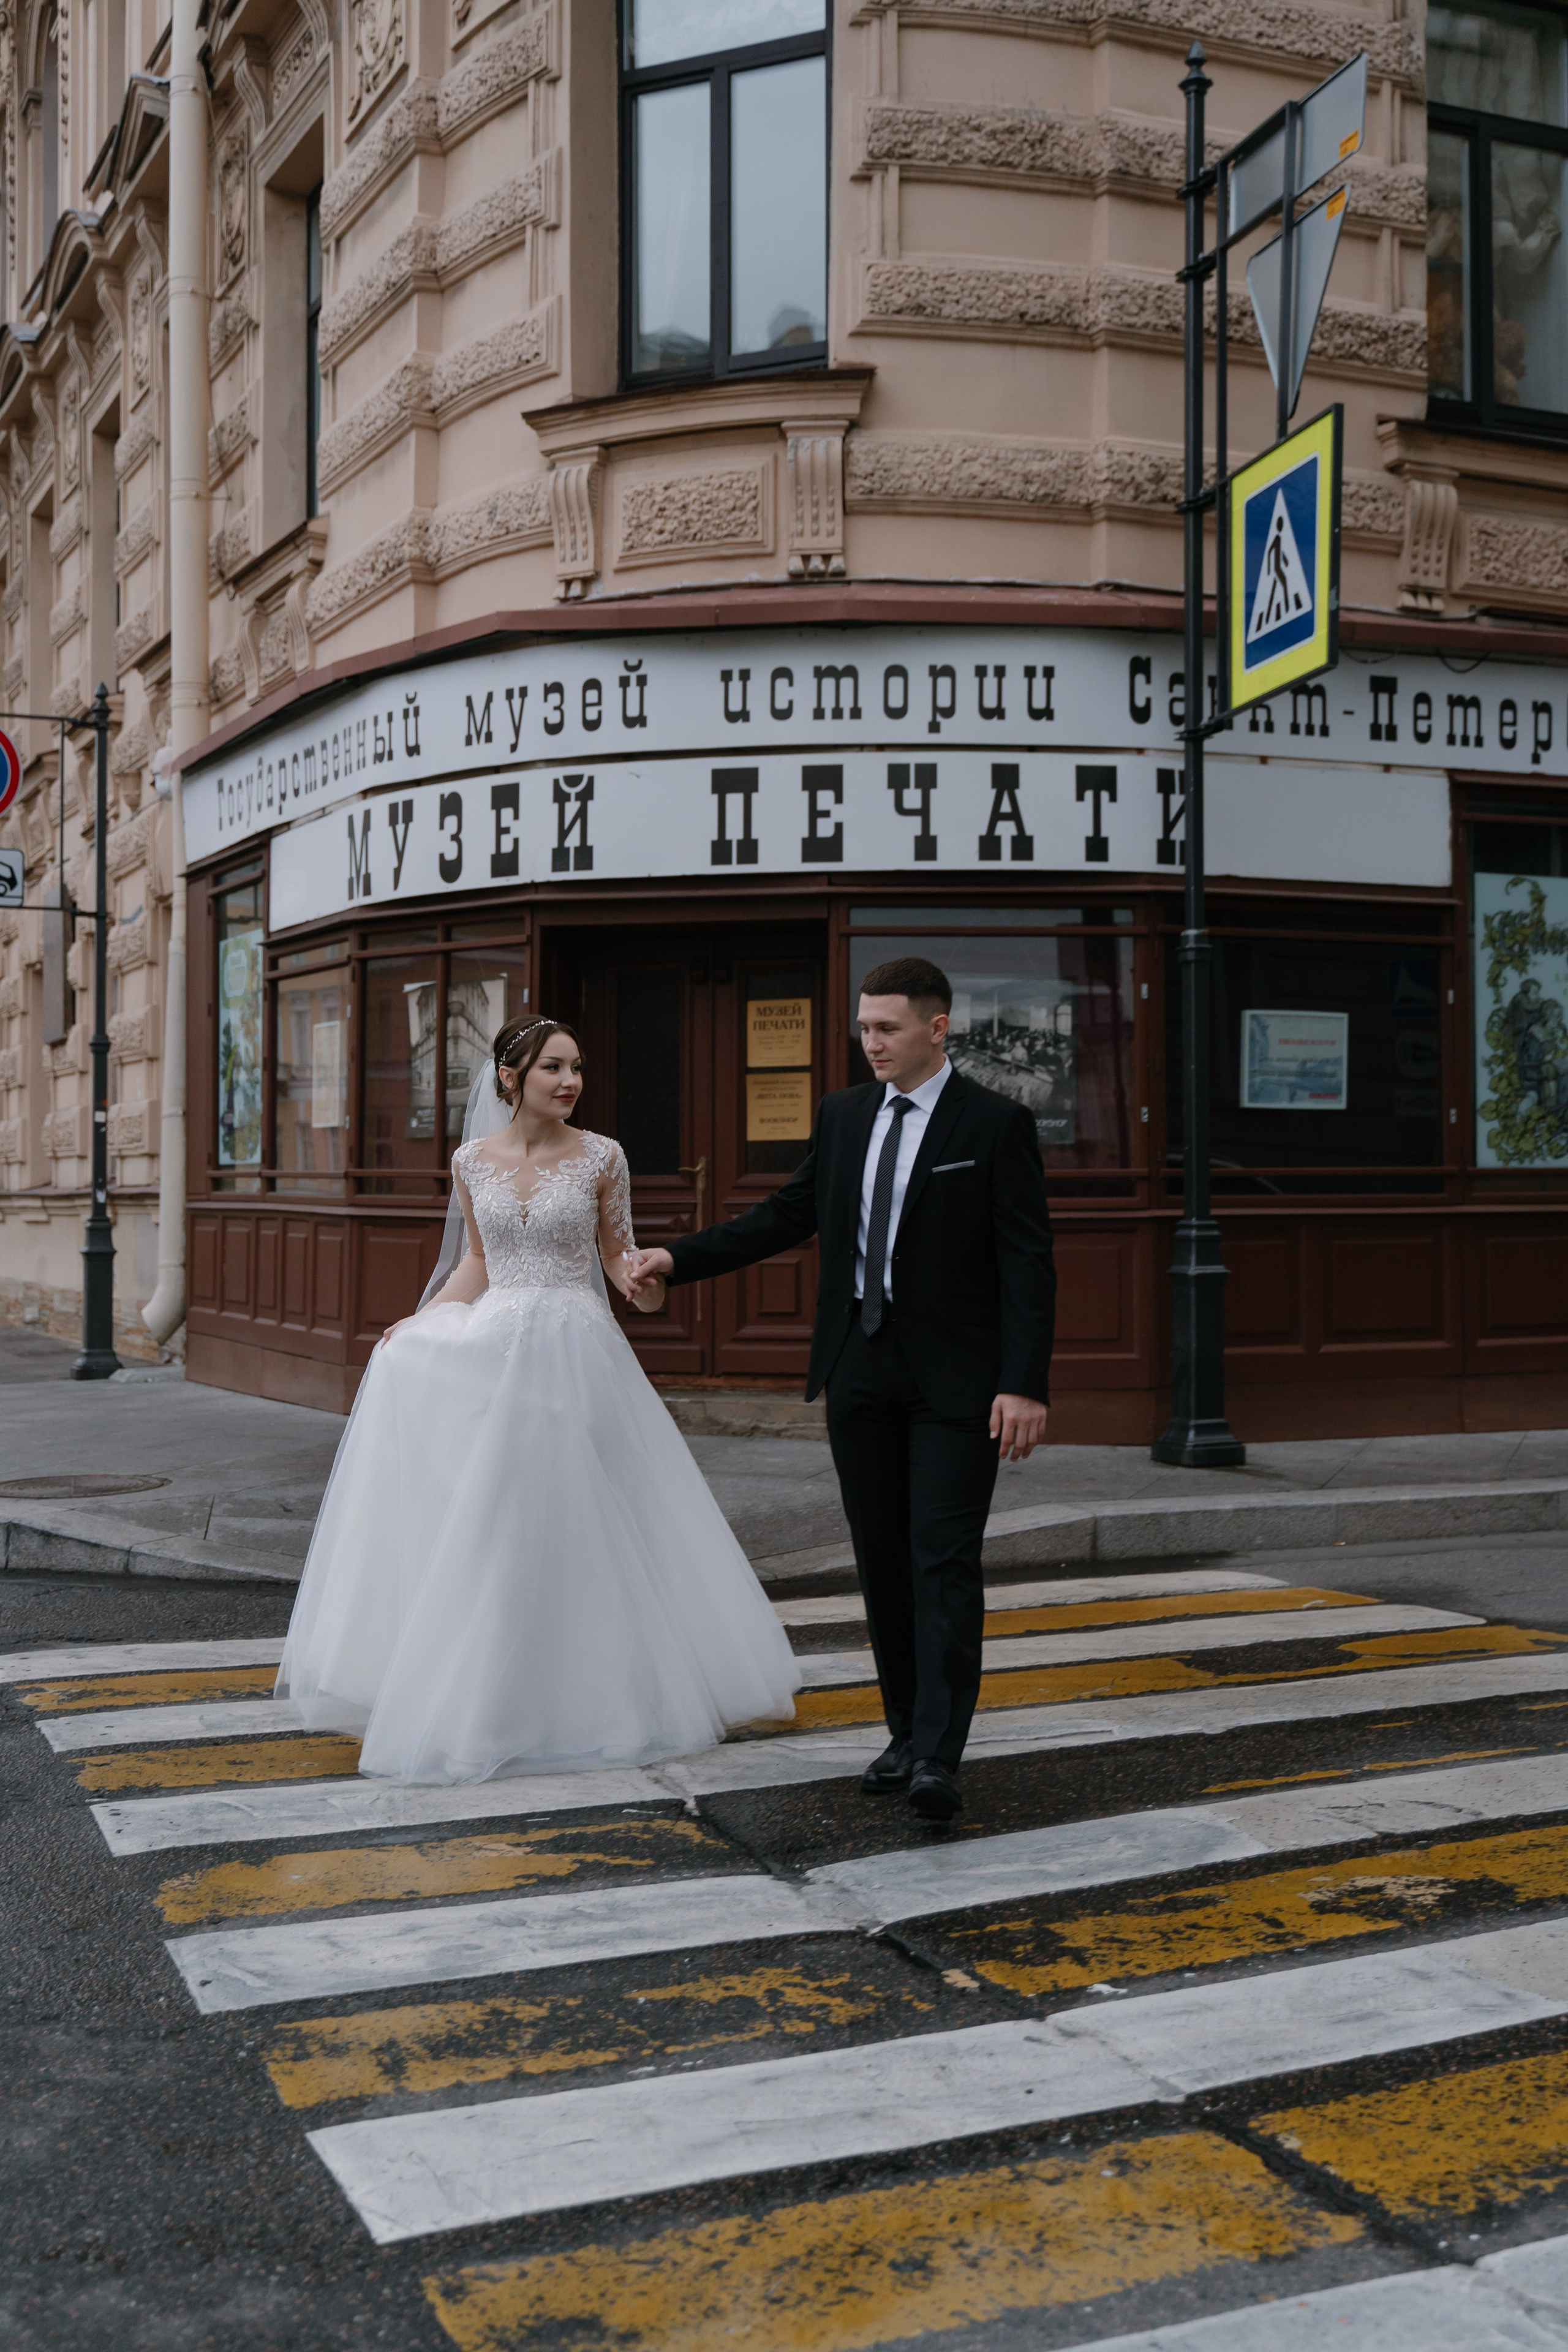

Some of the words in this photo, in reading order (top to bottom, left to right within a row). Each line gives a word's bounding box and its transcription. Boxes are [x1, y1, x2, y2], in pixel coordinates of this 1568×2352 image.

[217, 692, 421, 831] Государственный
[465, 658, 647, 753] музей
[720, 664, 1055, 734] истории
[1129, 654, 1568, 764] Сакт-Петер
[347, 774, 594, 900] МУЗЕЙ
[710, 763, 1186, 866] ПЕЧАТИ
